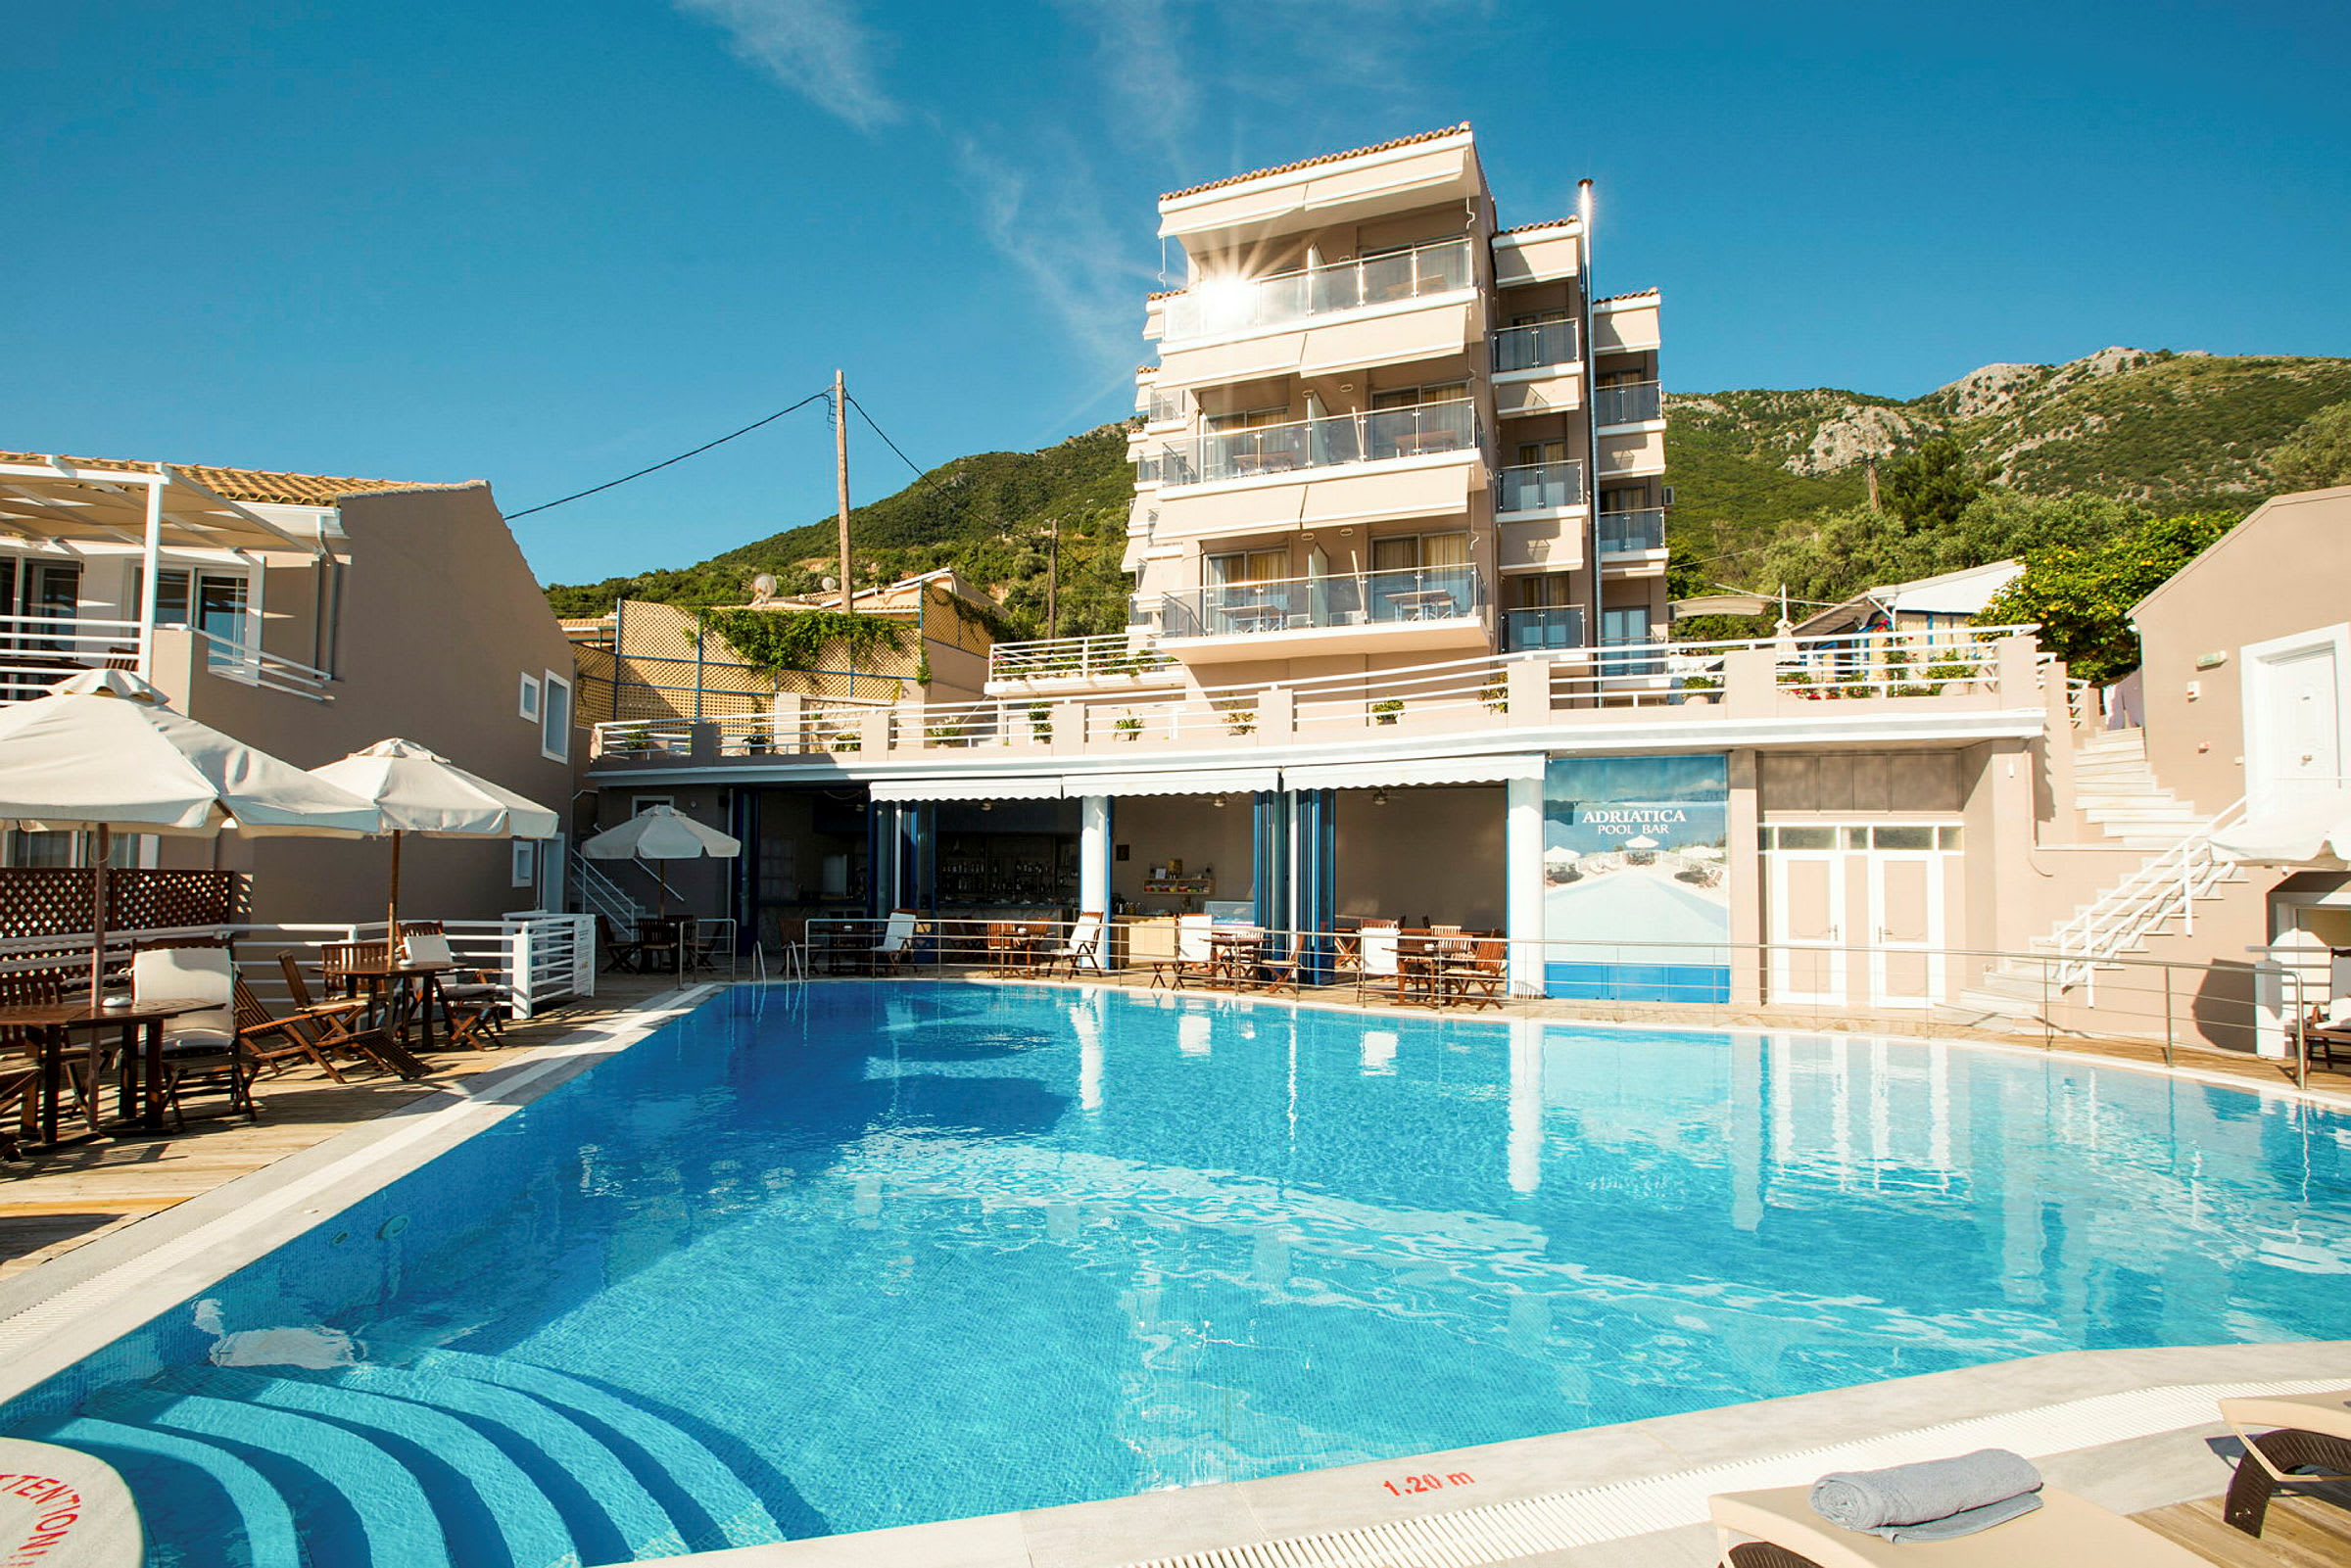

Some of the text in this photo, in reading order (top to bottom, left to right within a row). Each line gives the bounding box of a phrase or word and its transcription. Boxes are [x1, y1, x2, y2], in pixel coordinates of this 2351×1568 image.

[1582, 809, 1687, 824] ADRIATICA
[1598, 824, 1670, 835] POOL BAR
[1383, 1471, 1475, 1497] 1.20 m
